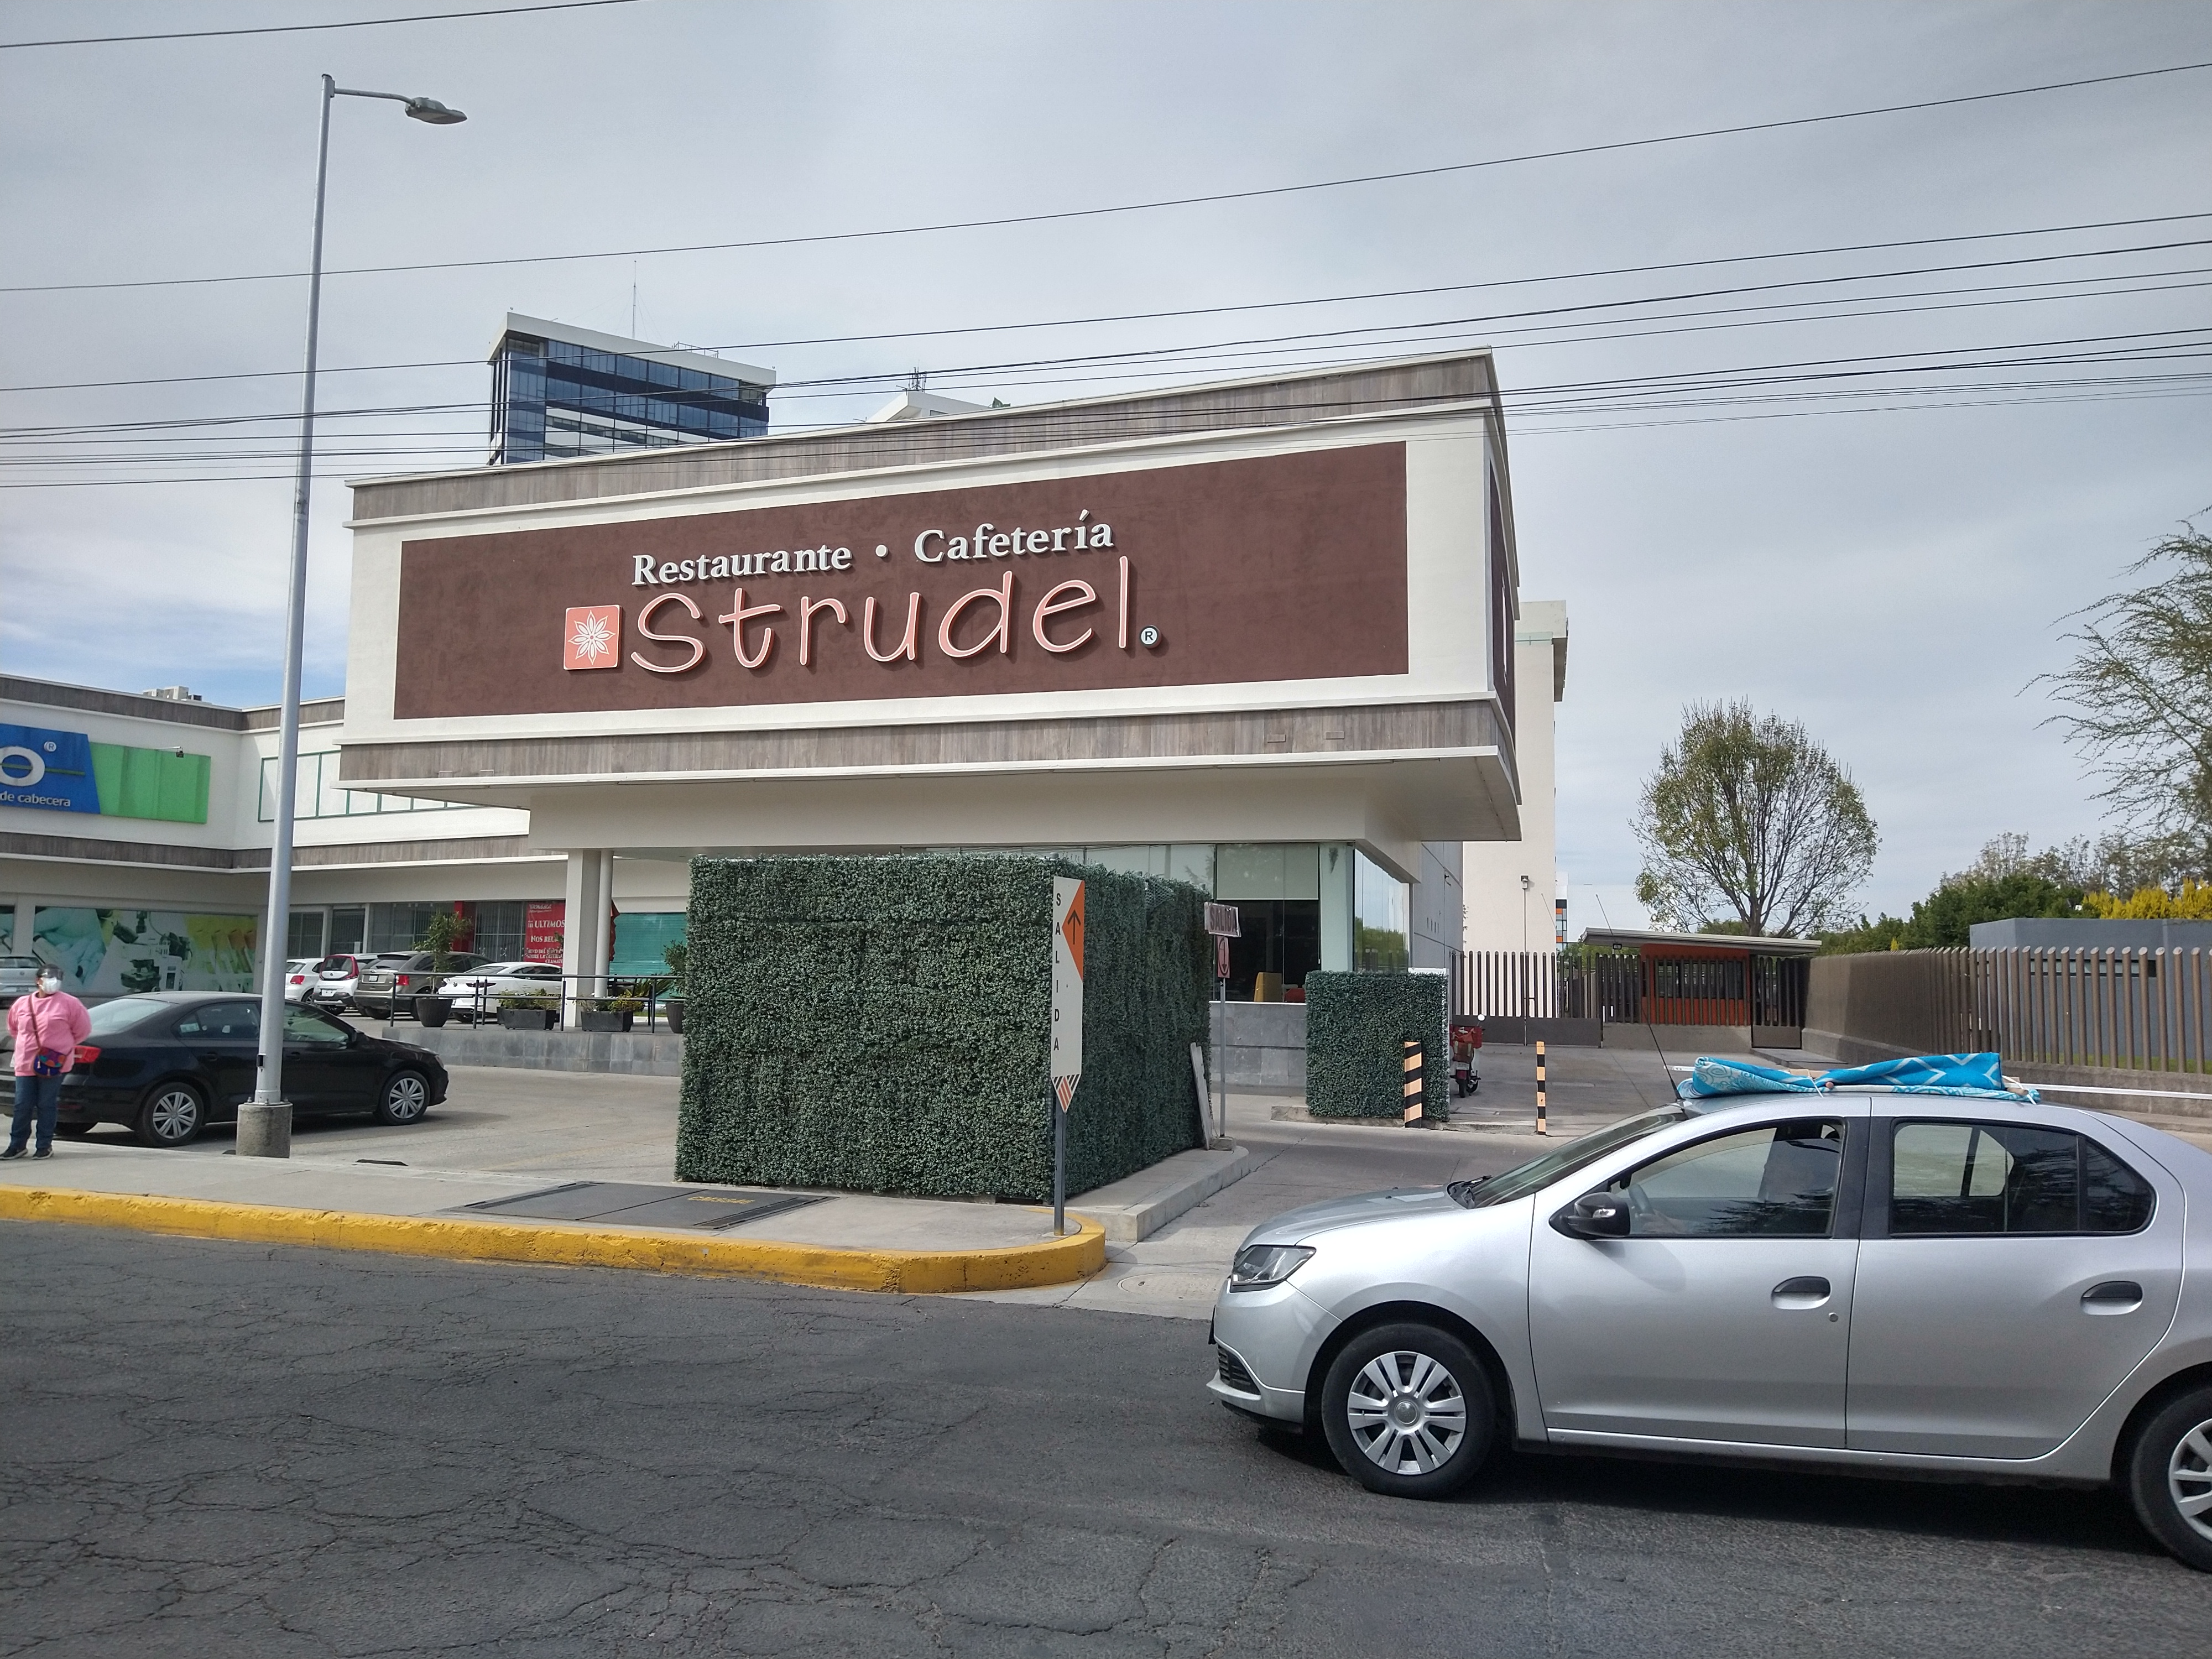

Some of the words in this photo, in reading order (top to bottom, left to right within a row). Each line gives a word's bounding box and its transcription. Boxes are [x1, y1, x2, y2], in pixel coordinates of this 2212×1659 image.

[632, 545, 852, 586] Restaurante
[914, 509, 1114, 563] Cafetería
[631, 556, 1130, 673] Strudel
[0, 791, 14, 802] de
[17, 794, 71, 807] cabecera
[1210, 906, 1236, 932] SALIDA
[1053, 893, 1061, 1051] SALIDA
